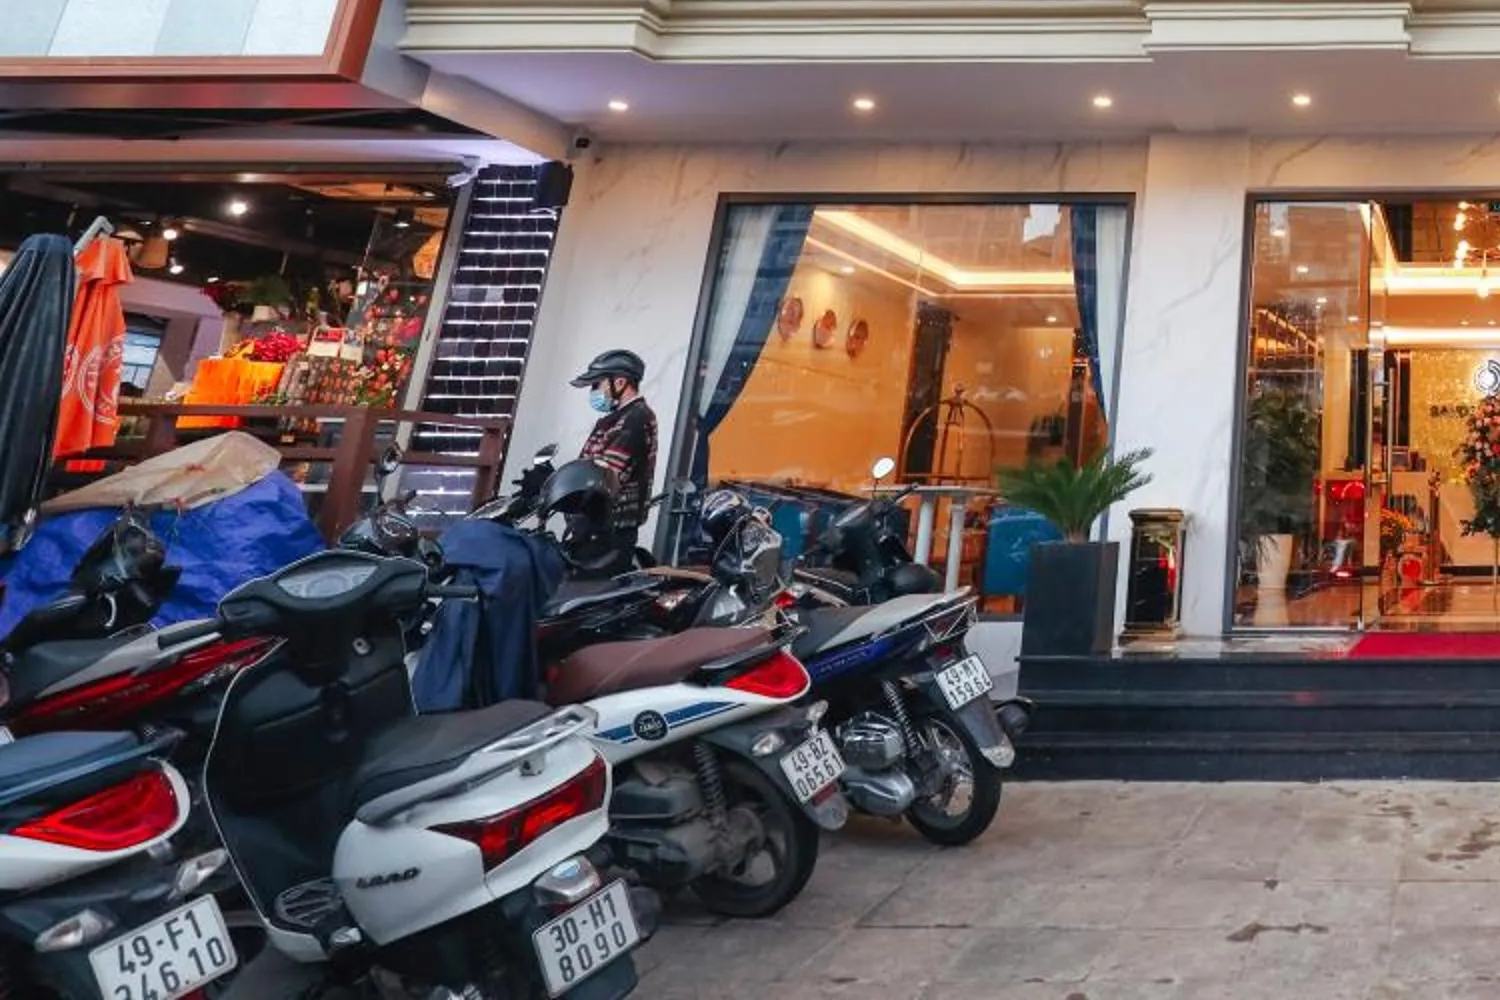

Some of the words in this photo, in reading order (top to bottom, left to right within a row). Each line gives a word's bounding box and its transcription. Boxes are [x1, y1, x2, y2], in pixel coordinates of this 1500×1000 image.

[118, 910, 203, 975] 49-F1
[549, 892, 617, 953] 30-H1
[559, 921, 627, 983] 8090
